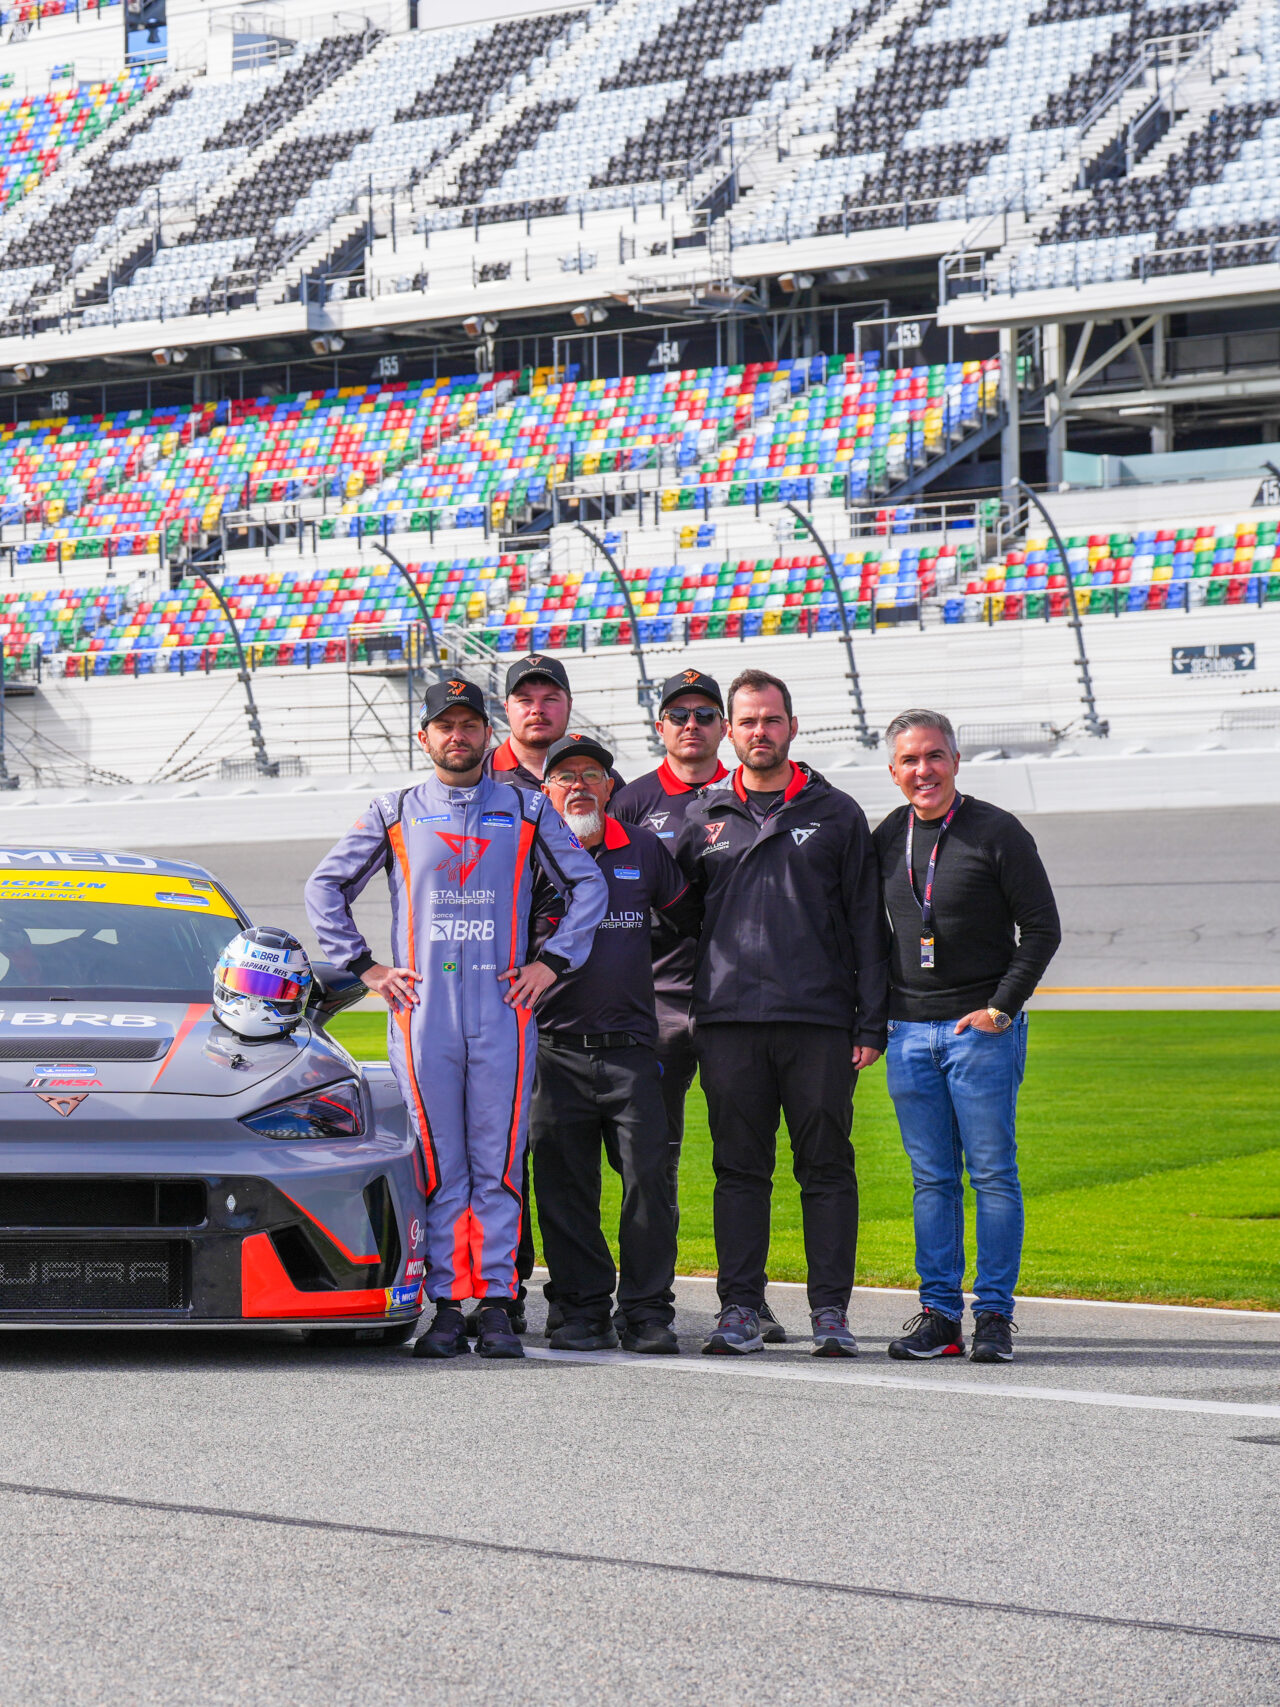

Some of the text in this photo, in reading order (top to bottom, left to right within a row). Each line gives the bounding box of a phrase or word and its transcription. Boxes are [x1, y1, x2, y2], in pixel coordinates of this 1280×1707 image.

[896, 322, 921, 348] 153
[657, 341, 680, 364] 154
[379, 355, 400, 377] 155
[51, 391, 70, 411] 156
[1, 890, 87, 899] CHALLENGE
[430, 890, 495, 899] STALLION
[603, 911, 644, 921] LION
[453, 919, 495, 941] BRB
[599, 921, 643, 929] RSPORTS
[260, 951, 280, 963] BRB
[240, 960, 288, 977] RAPHAEL REIS
[9, 1012, 158, 1028] BRB
[49, 1079, 104, 1087] IMSA
